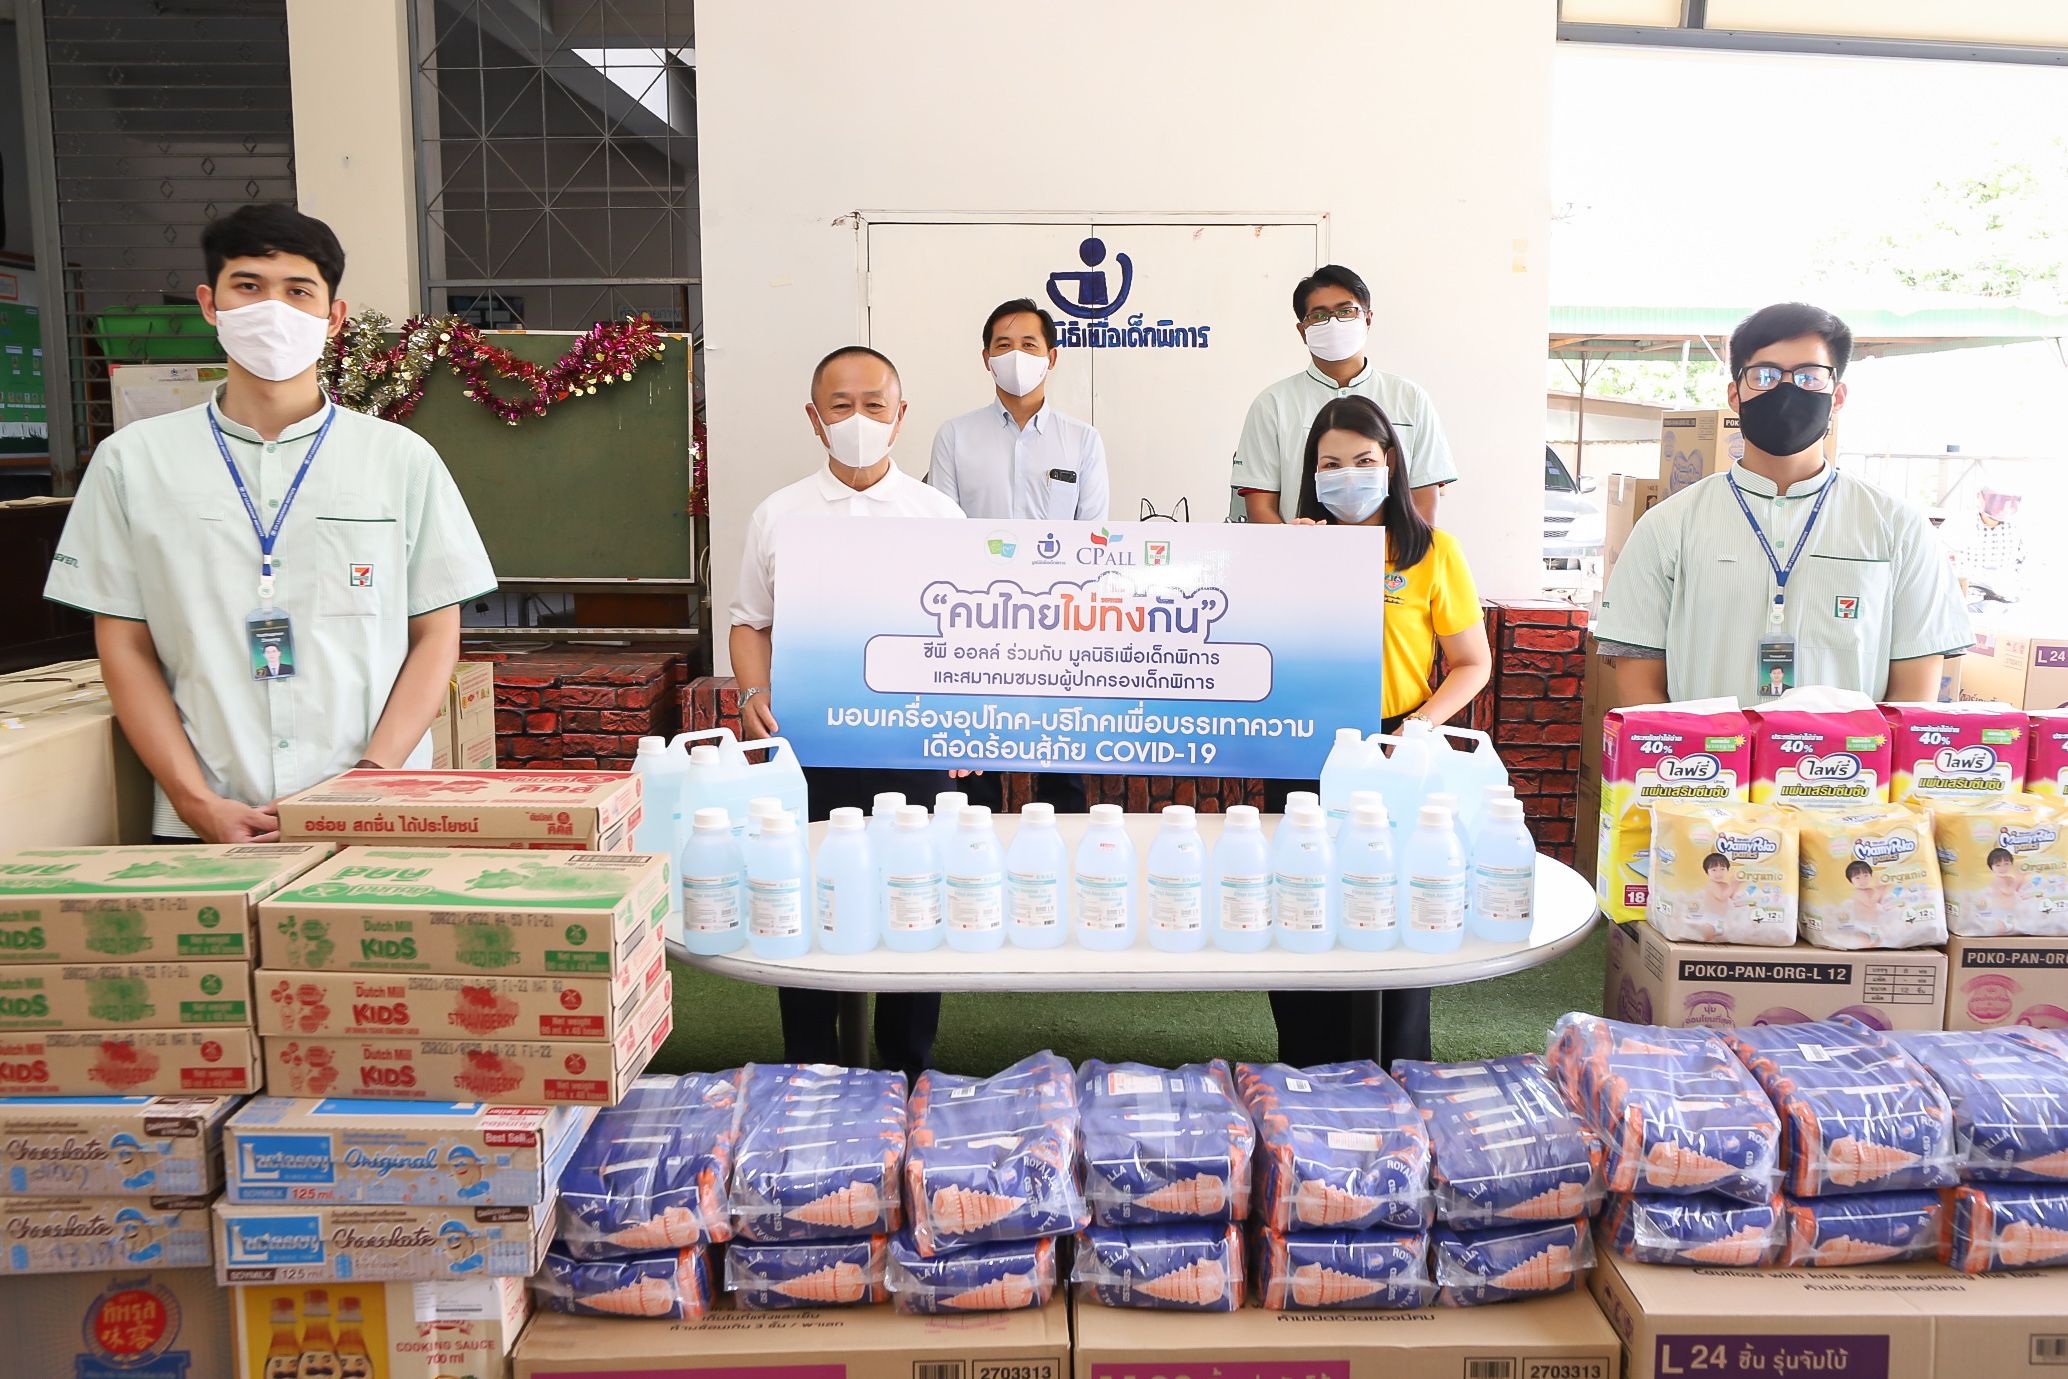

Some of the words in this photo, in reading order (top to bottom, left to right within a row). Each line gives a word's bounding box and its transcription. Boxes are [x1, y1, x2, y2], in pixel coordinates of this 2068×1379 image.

[923, 643, 947, 663] ซีพี
[955, 644, 1000, 664] ออลล์
[1006, 643, 1063, 664] ร่วมกับ
[1068, 645, 1221, 669] มูลนิธิเพื่อเด็กพิการ
[2049, 650, 2066, 662] 24
[933, 668, 1215, 692] และสมาคมชมรมผู้ปกครองเด็กพิการ
[827, 695, 1315, 738] มอบเครื่องอุปโภค-บริโภคเพื่อบรรเทาความ
[1918, 733, 1951, 745] 40%
[922, 735, 1085, 768] เดือดร้อนสู้ภัย
[1095, 741, 1217, 765] COVID-19
[1640, 741, 1673, 754] 40%
[1780, 741, 1813, 754] 40%
[1944, 751, 1987, 768] ไลฟ์รี่
[1666, 760, 1710, 777] ไลฟ์รี่
[1805, 760, 1851, 776] ไลฟ์รี่
[1641, 783, 1730, 798] แผ่นเสริมซึมซับ
[1780, 784, 1870, 798] แผ่นเสริมซึมซับ
[1918, 776, 2005, 791] แผ่นเสริมซึมซับ
[305, 819, 346, 834] อร่อย
[353, 812, 395, 833] สดชื่น
[400, 814, 479, 834] ได้ประโยชน์
[1627, 893, 1646, 904] 18
[360, 937, 418, 960] KIDS
[1684, 965, 1822, 980] POKO-PAN-ORG-L
[1827, 968, 1847, 980] 12
[352, 1002, 410, 1026] KIDS
[360, 1065, 417, 1088] KIDS
[242, 1142, 331, 1180] Lactasoy
[344, 1147, 438, 1177] Original
[291, 1187, 316, 1199] 125
[231, 1225, 322, 1262] Lactasoy
[280, 1268, 306, 1280] 125
[1768, 1270, 1804, 1280] with
[1808, 1270, 1851, 1280] knife
[1856, 1272, 1901, 1281] when
[396, 1341, 451, 1353] COOKING
[455, 1339, 496, 1350] SAUCE
[426, 1354, 447, 1366] 700
[449, 1352, 464, 1364] ml
[1662, 1345, 1684, 1374] L
[1690, 1344, 1728, 1370] 24
[1738, 1342, 1765, 1370] ชิ้น
[1772, 1348, 1849, 1376] รุ่นจัมโบ้
[980, 1366, 1052, 1379] 2703313
[1530, 1365, 1601, 1379] 2703313
